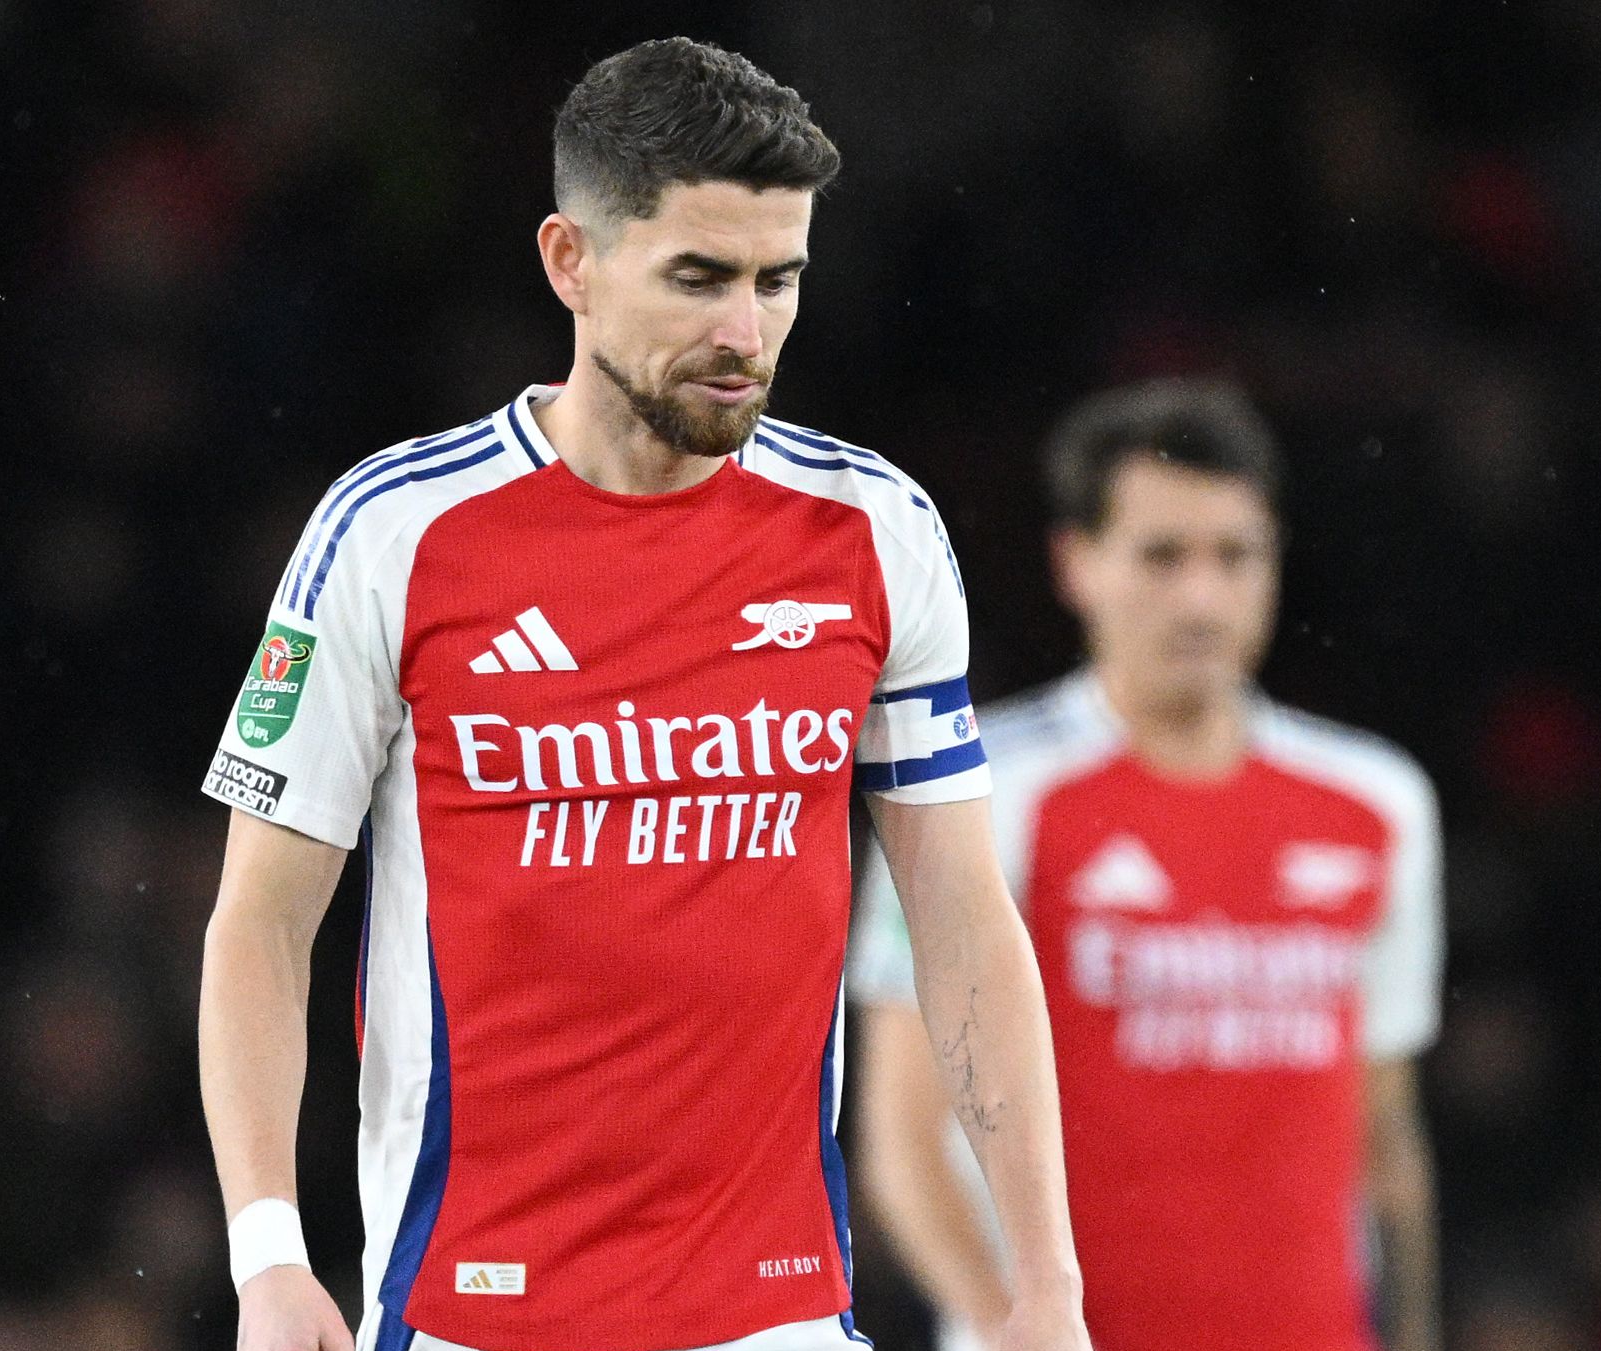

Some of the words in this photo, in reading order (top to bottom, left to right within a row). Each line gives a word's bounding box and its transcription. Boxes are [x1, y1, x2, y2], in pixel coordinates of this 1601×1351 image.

[246, 676, 299, 694] Carabao
[250, 694, 277, 712] Cup
[449, 697, 853, 793] Emirates
[226, 760, 275, 794] room
[218, 777, 277, 816] racism
[520, 801, 613, 868] FLY
[627, 792, 803, 866] BETTER
